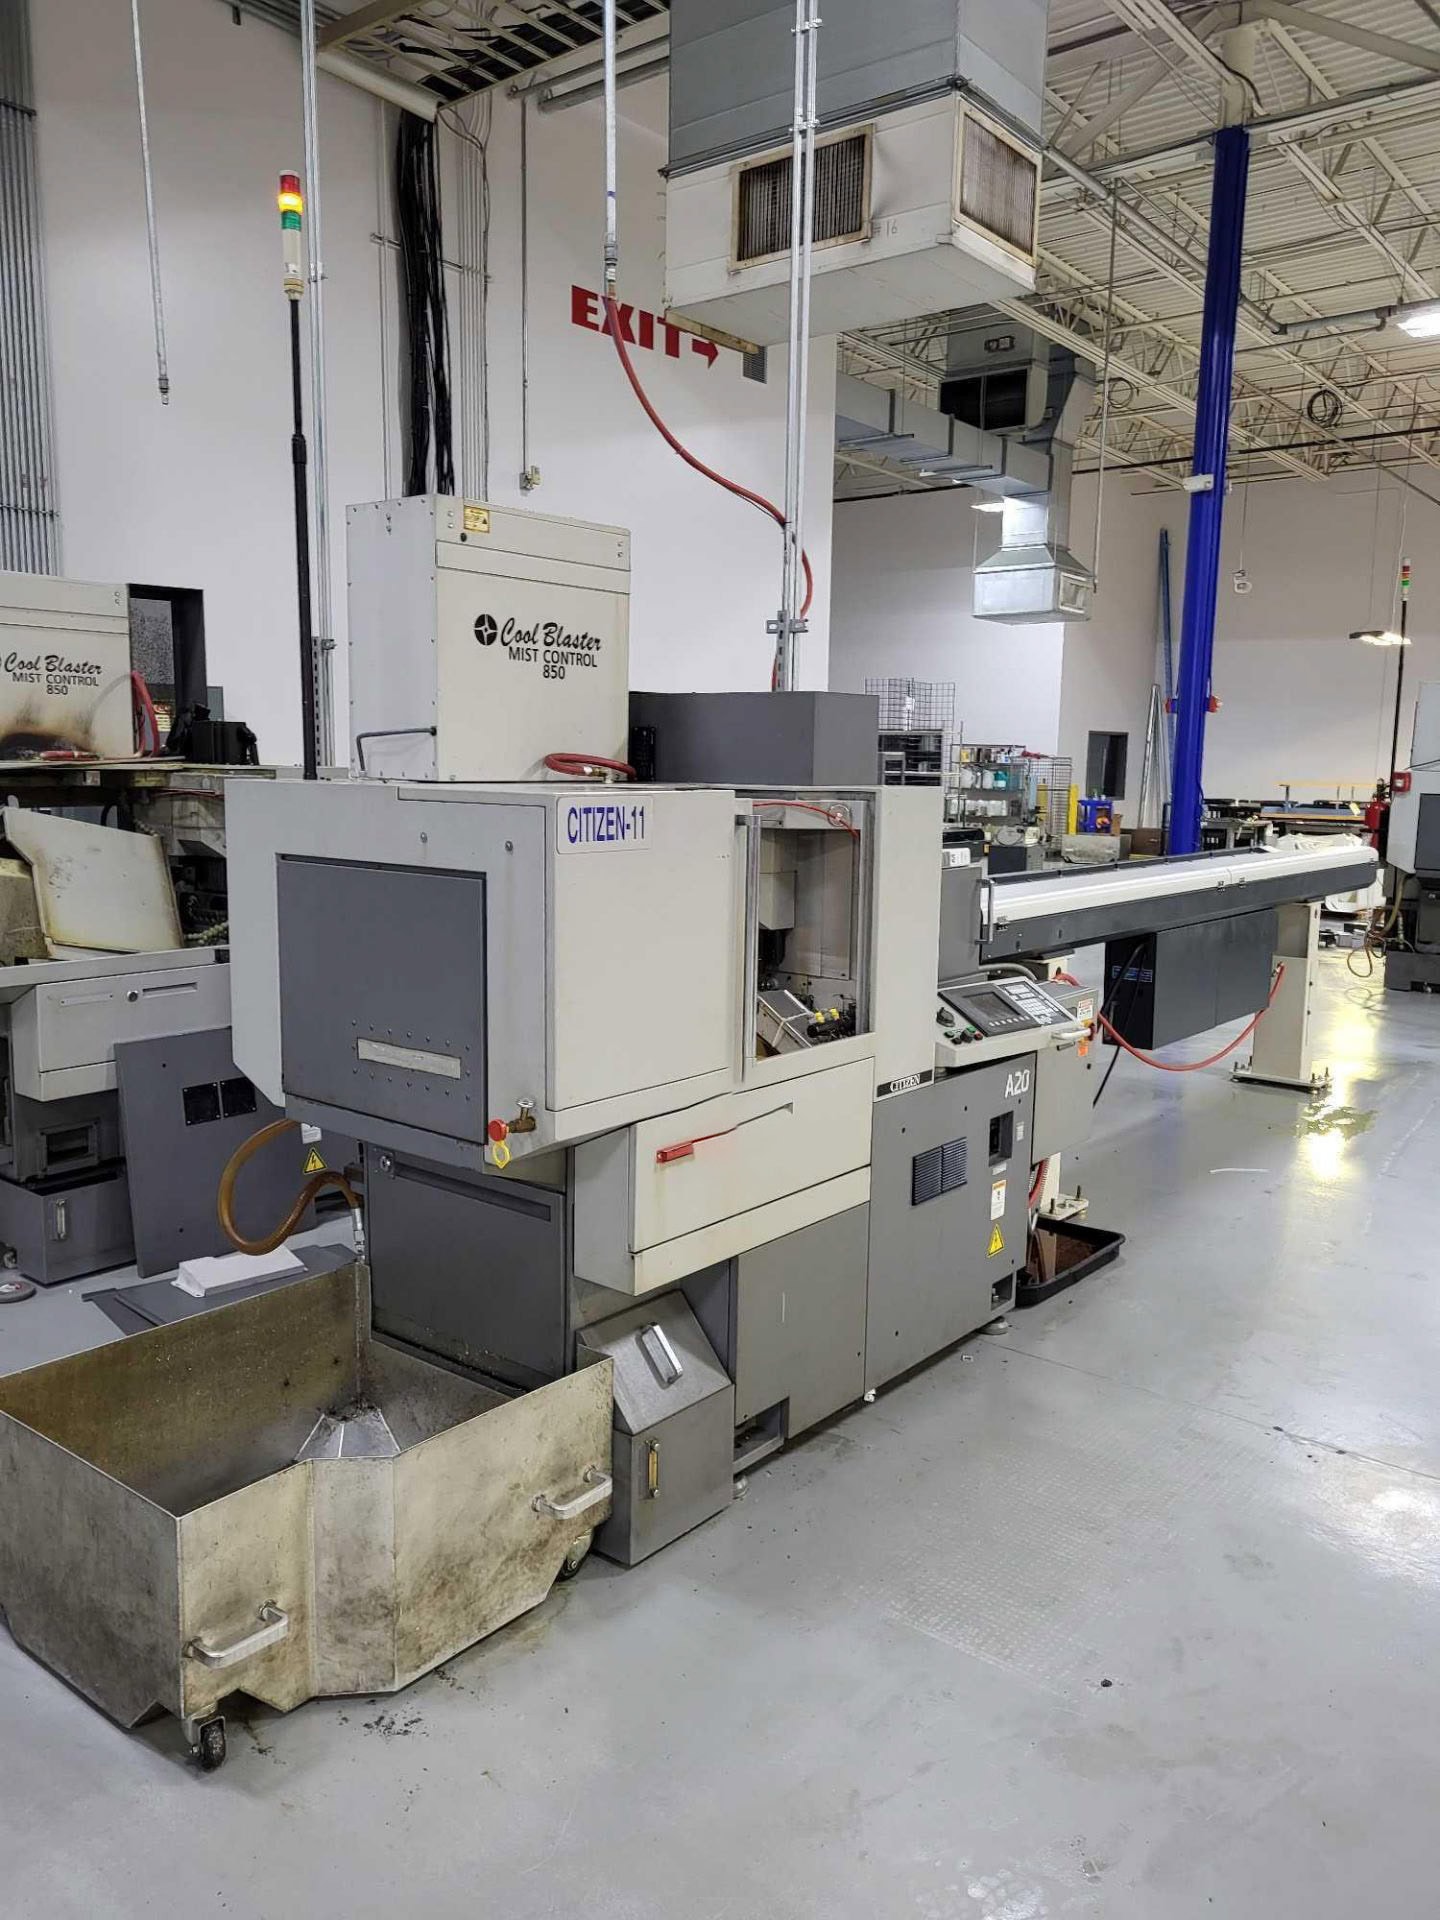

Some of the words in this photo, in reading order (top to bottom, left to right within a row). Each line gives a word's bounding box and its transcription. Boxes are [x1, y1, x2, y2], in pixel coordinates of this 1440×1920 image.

[571, 285, 680, 358] EXIT
[501, 617, 539, 646] Cool
[543, 622, 600, 651] Blaster
[4, 652, 40, 672] Cool
[44, 655, 102, 674] Blaster
[508, 646, 538, 662] MIST
[543, 649, 597, 667] CONTROL
[12, 672, 41, 683] MIST
[46, 674, 98, 686] CONTROL
[543, 664, 565, 679] 850
[46, 684, 68, 695] 850
[567, 805, 645, 843] CITIZEN-11
[890, 1073, 920, 1092] CITIZEN
[1004, 1069, 1030, 1098] A20
